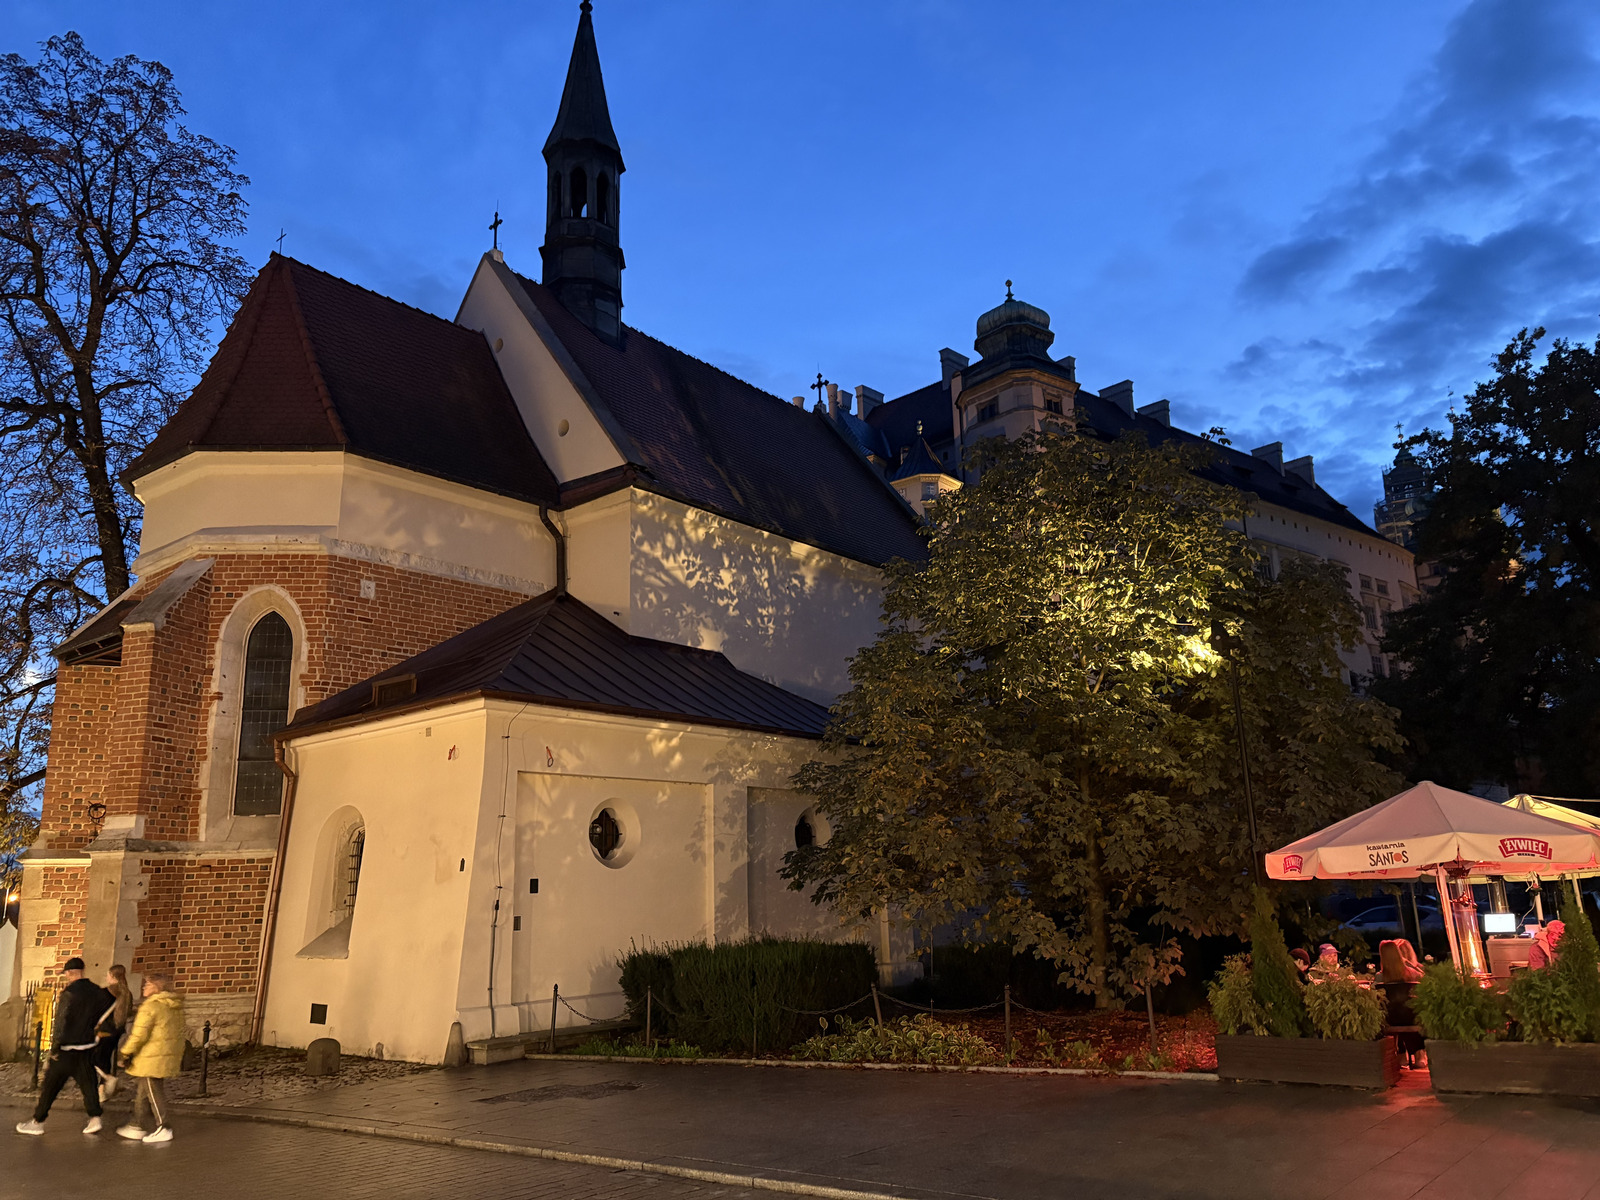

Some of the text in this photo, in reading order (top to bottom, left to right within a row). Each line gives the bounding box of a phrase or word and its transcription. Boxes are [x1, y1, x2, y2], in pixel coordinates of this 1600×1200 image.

[1366, 842, 1406, 851] kawiarnia
[1503, 838, 1546, 853] ŻYWIEC
[1368, 850, 1410, 867] SANTOS
